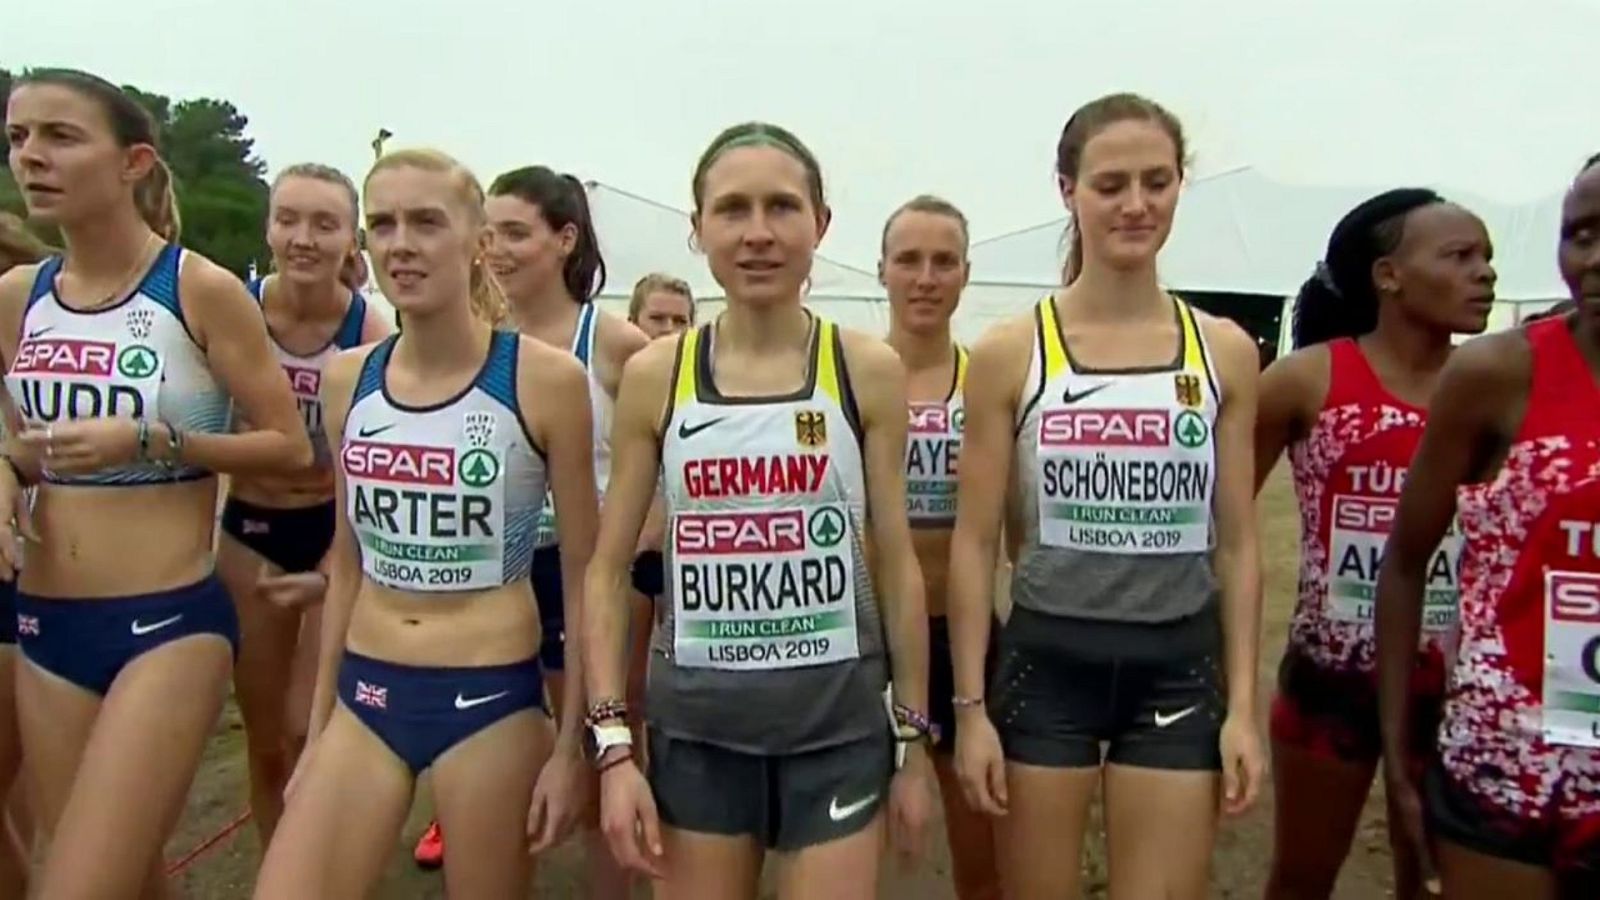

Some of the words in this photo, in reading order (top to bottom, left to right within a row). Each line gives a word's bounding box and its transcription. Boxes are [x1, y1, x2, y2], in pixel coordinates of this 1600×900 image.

[17, 344, 110, 371] SPAR
[20, 379, 144, 421] JUDD
[1044, 413, 1166, 441] SPAR
[345, 444, 450, 480] SPAR
[907, 439, 961, 475] AYE
[683, 454, 829, 499] GERMANY
[1043, 452, 1208, 502] SCHÖNEBORN
[354, 484, 493, 537] ARTER
[1119, 509, 1171, 522] CLEAN
[678, 516, 801, 549] SPAR
[1069, 526, 1138, 546] LISBOA
[1141, 530, 1181, 547] 2019
[407, 545, 459, 559] CLEAN
[374, 559, 424, 584] LISBOA
[428, 567, 472, 584] 2019
[681, 555, 846, 612] BURKARD
[719, 621, 755, 636] RUN
[759, 617, 815, 635] CLEAN
[708, 643, 781, 662] LISBOA
[786, 638, 830, 660] 2019
